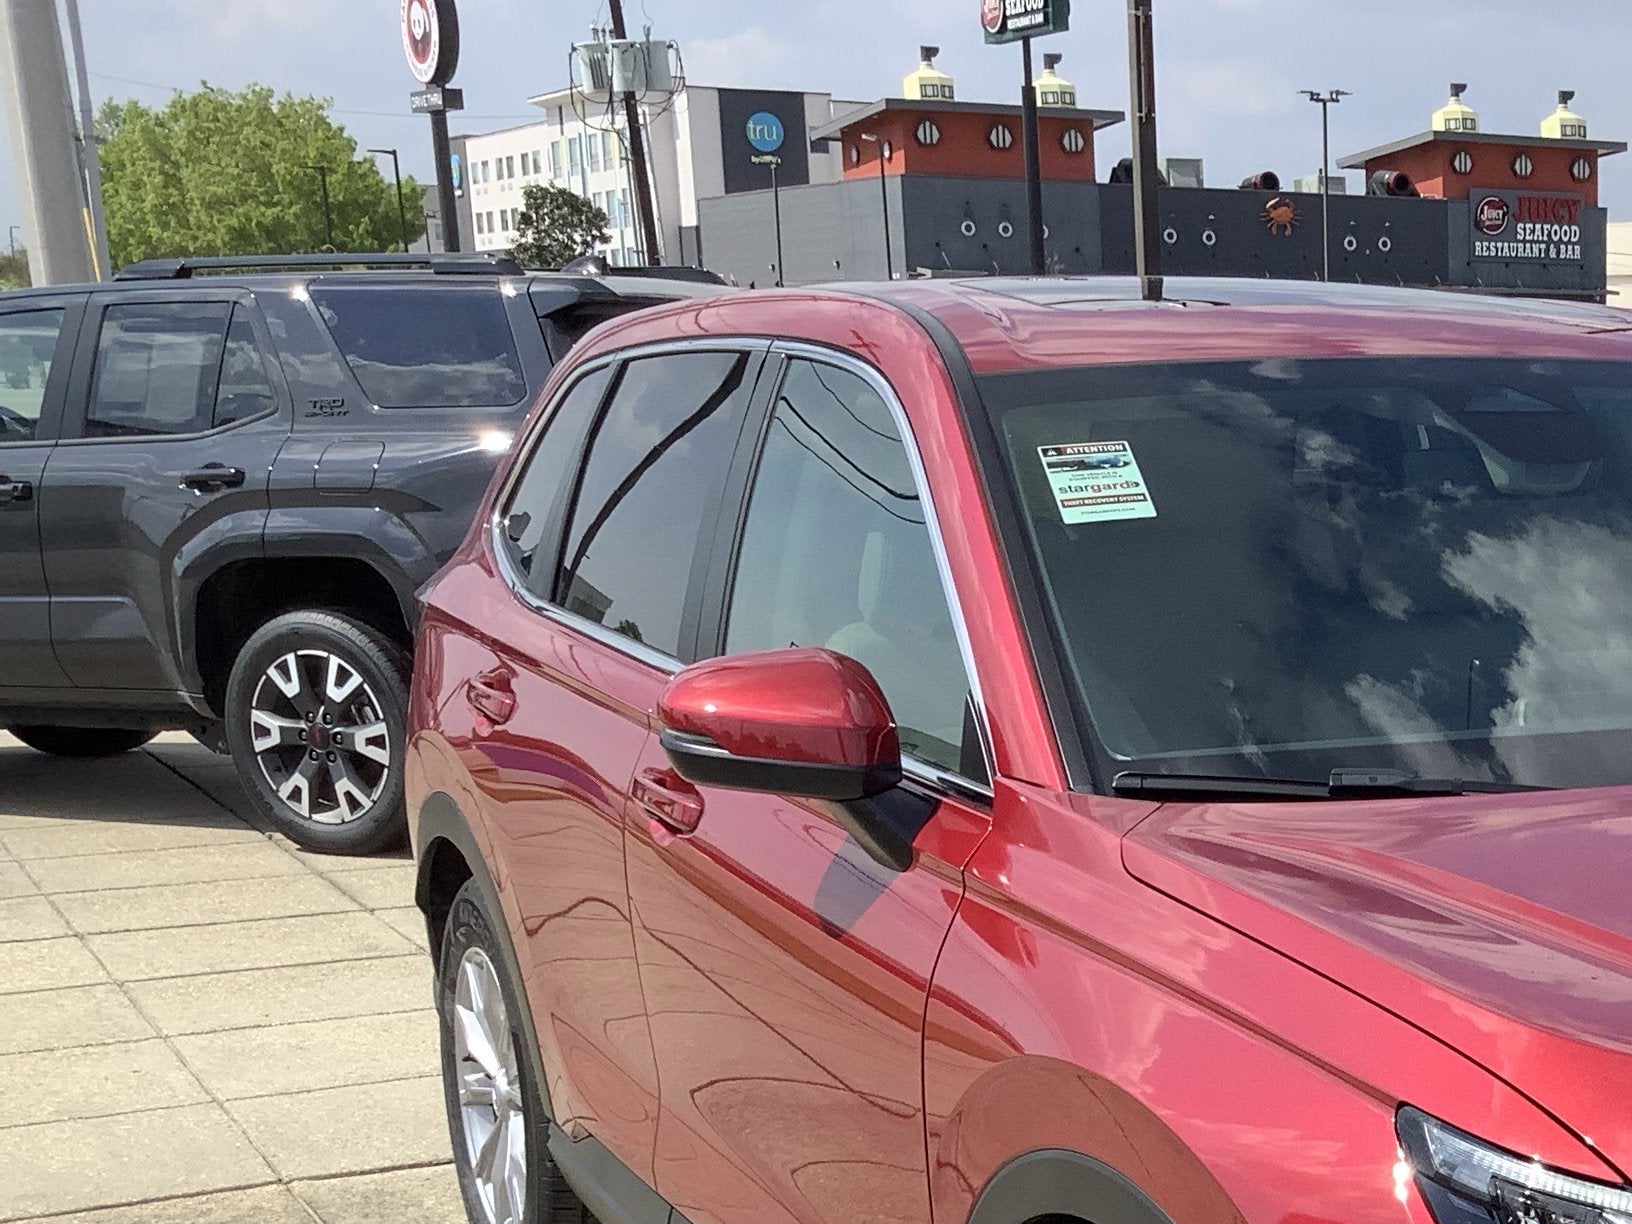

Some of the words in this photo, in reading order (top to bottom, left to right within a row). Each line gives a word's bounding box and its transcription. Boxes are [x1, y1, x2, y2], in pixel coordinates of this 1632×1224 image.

[1005, 0, 1044, 16] SEAFOOD
[746, 119, 777, 141] tru
[1512, 197, 1580, 224] JUICY
[1516, 222, 1580, 242] SEAFOOD
[1475, 241, 1547, 258] RESTAURANT
[1549, 244, 1557, 259] &
[1560, 245, 1581, 259] BAR
[1066, 444, 1123, 454] ATTENTION
[1063, 499, 1083, 507] THEFT
[1084, 497, 1117, 505] RECOVERY
